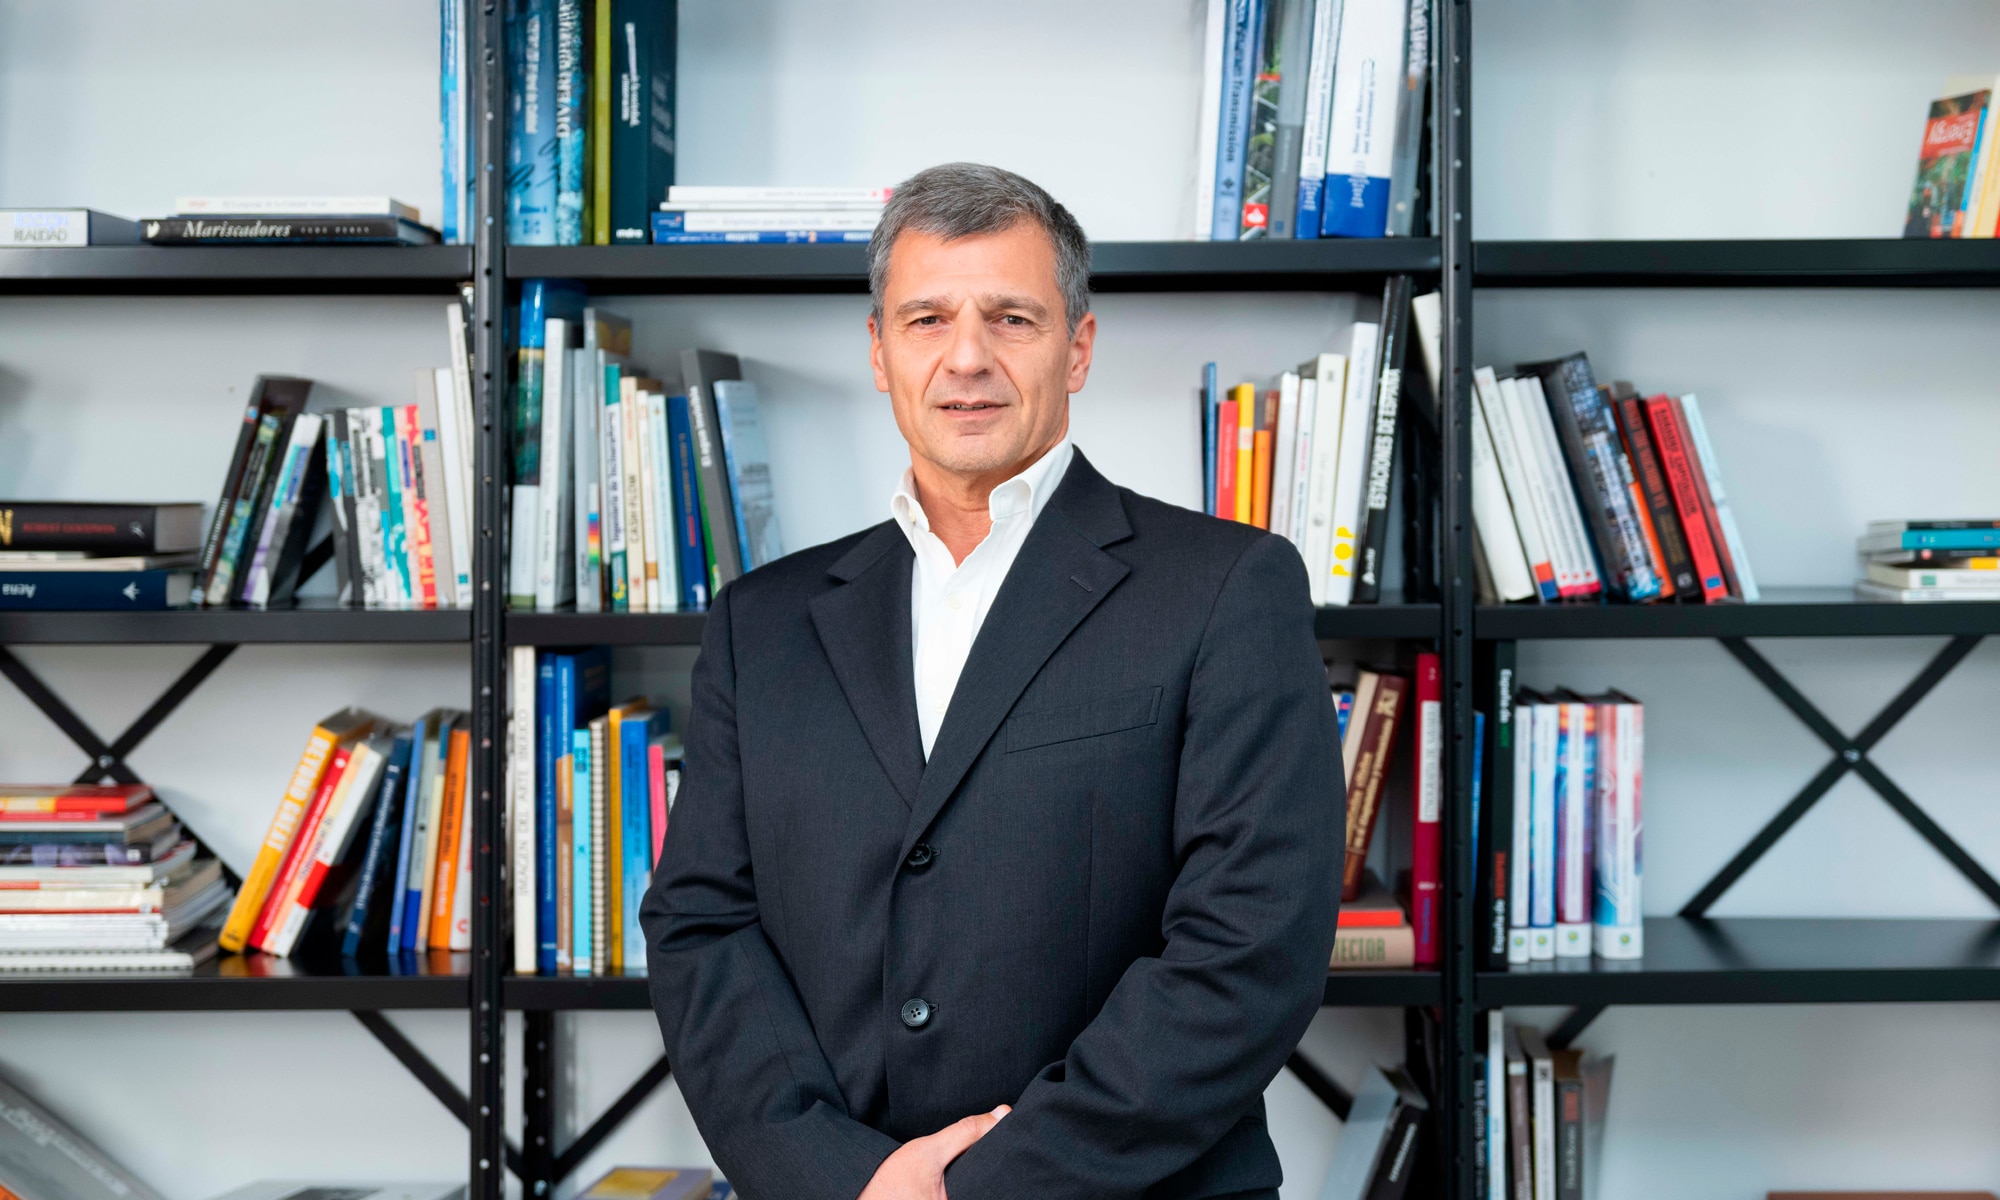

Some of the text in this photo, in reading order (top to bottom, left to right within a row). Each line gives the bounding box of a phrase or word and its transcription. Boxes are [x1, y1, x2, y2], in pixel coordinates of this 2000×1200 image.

[182, 220, 292, 238] Mariscadores
[1378, 415, 1395, 435] DE
[1368, 435, 1393, 510] ESTACIONES
[630, 473, 641, 544] CASH FLOW
[1332, 525, 1354, 577] POP
[2, 583, 36, 598] Aena
[289, 736, 331, 800] BEYOND
[518, 776, 528, 804] ARTE
[518, 808, 528, 834] DEL
[518, 841, 528, 896] IMAGEN
